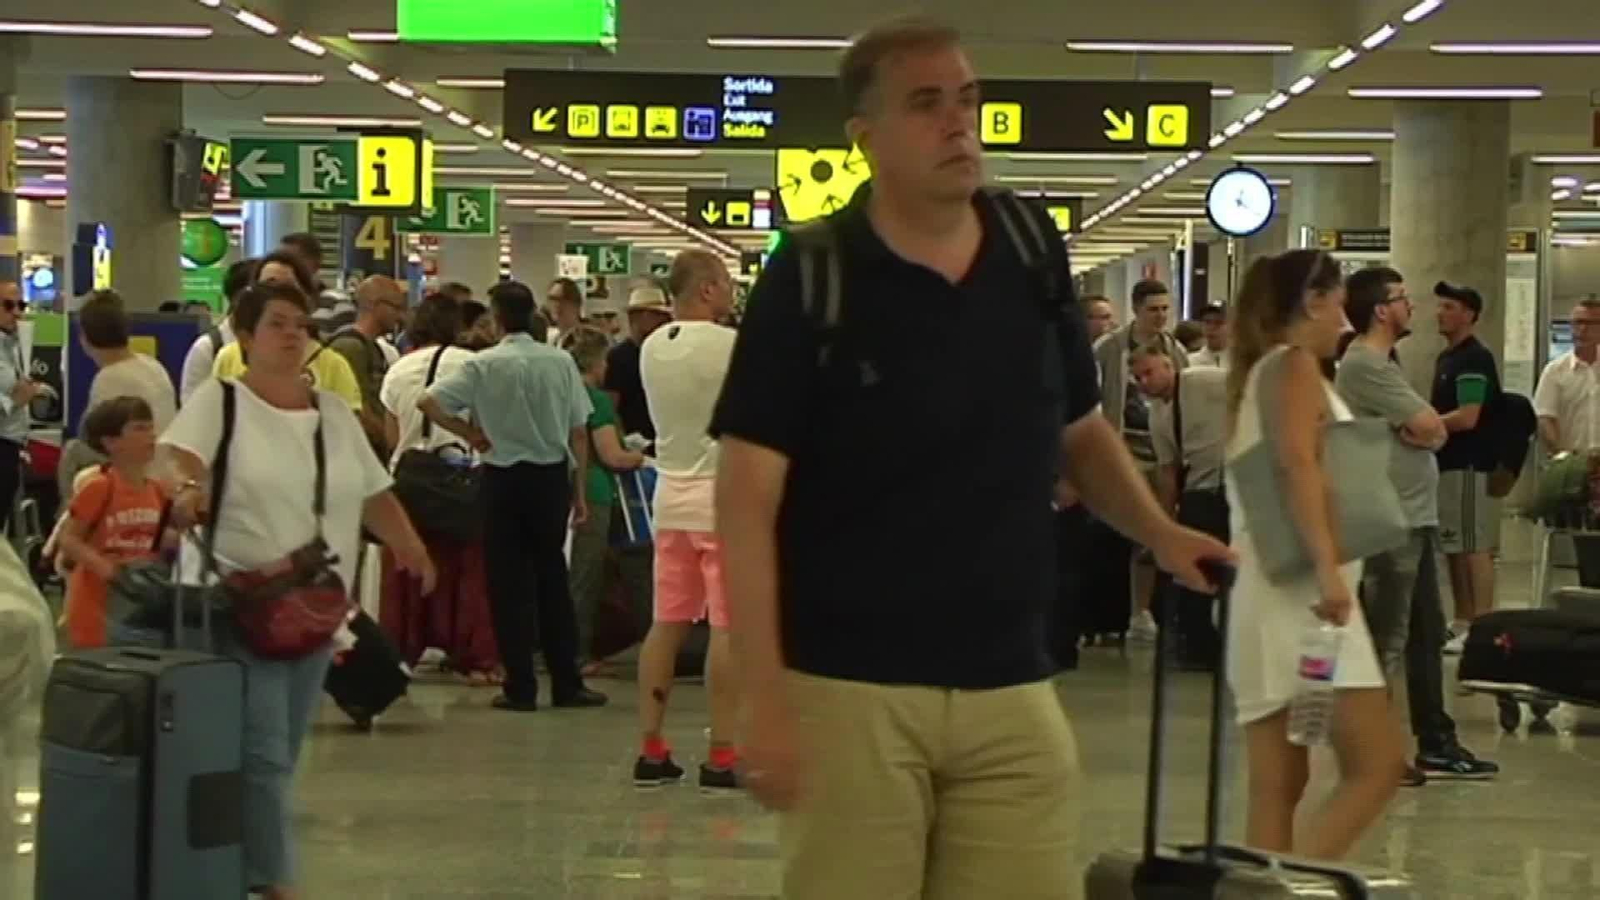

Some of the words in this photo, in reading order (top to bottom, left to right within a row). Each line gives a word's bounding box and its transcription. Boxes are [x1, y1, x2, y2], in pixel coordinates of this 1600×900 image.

[724, 77, 773, 93] Sortida
[724, 124, 765, 138] Salida
[993, 111, 1009, 134] B
[1159, 114, 1174, 137] C
[355, 215, 391, 259] 4
